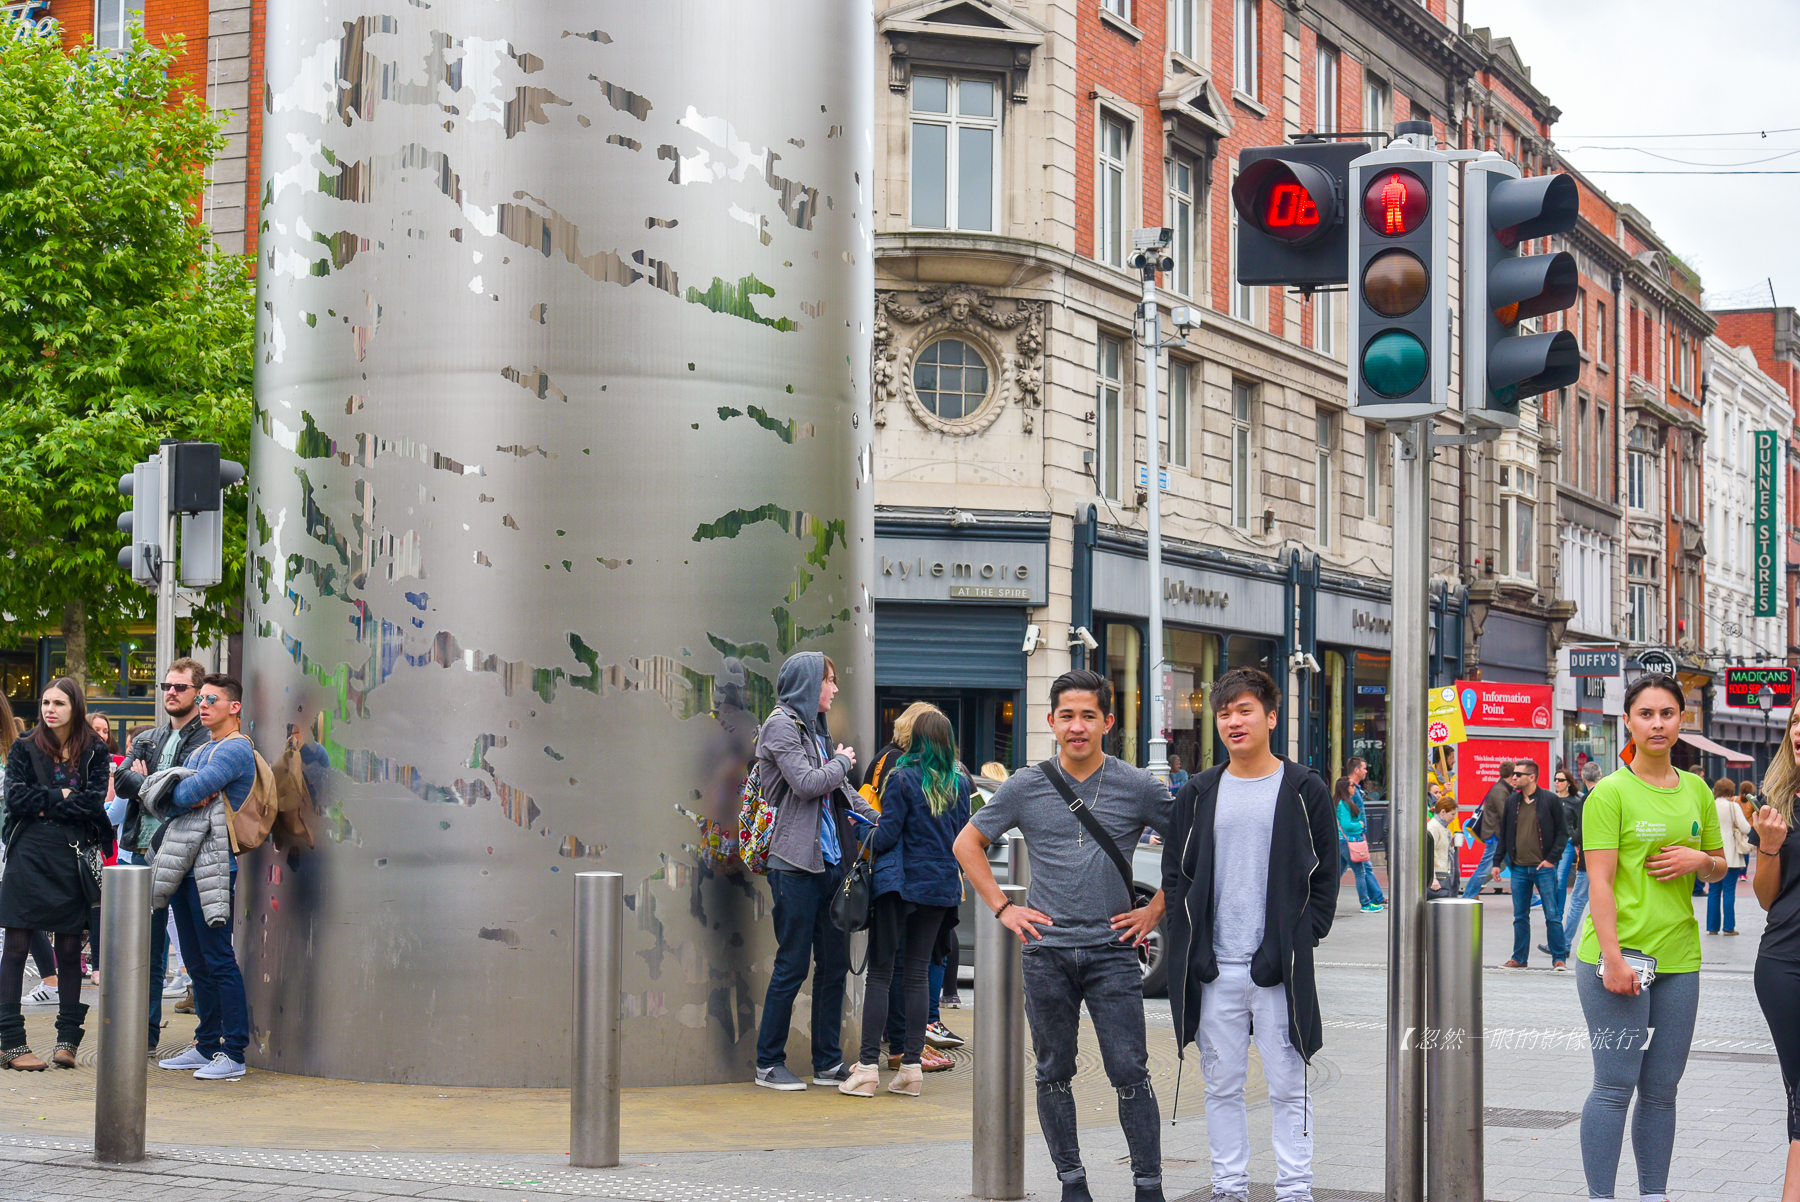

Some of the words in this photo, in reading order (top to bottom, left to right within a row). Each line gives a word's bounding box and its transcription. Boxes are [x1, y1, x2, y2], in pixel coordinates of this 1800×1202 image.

[1759, 434, 1772, 520] DUNNES
[881, 555, 1029, 581] kylemore
[1758, 524, 1772, 612] STORES
[958, 587, 972, 596] AT
[975, 588, 993, 596] THE
[998, 589, 1028, 598] SPIRE
[1163, 577, 1229, 609] kylemore
[1571, 653, 1618, 667] DUFFY'S
[1729, 684, 1748, 694] FOOD
[1772, 684, 1791, 694] DAILY
[1482, 691, 1531, 703] Information
[1482, 704, 1504, 714] Point
[1431, 728, 1447, 738] €10
